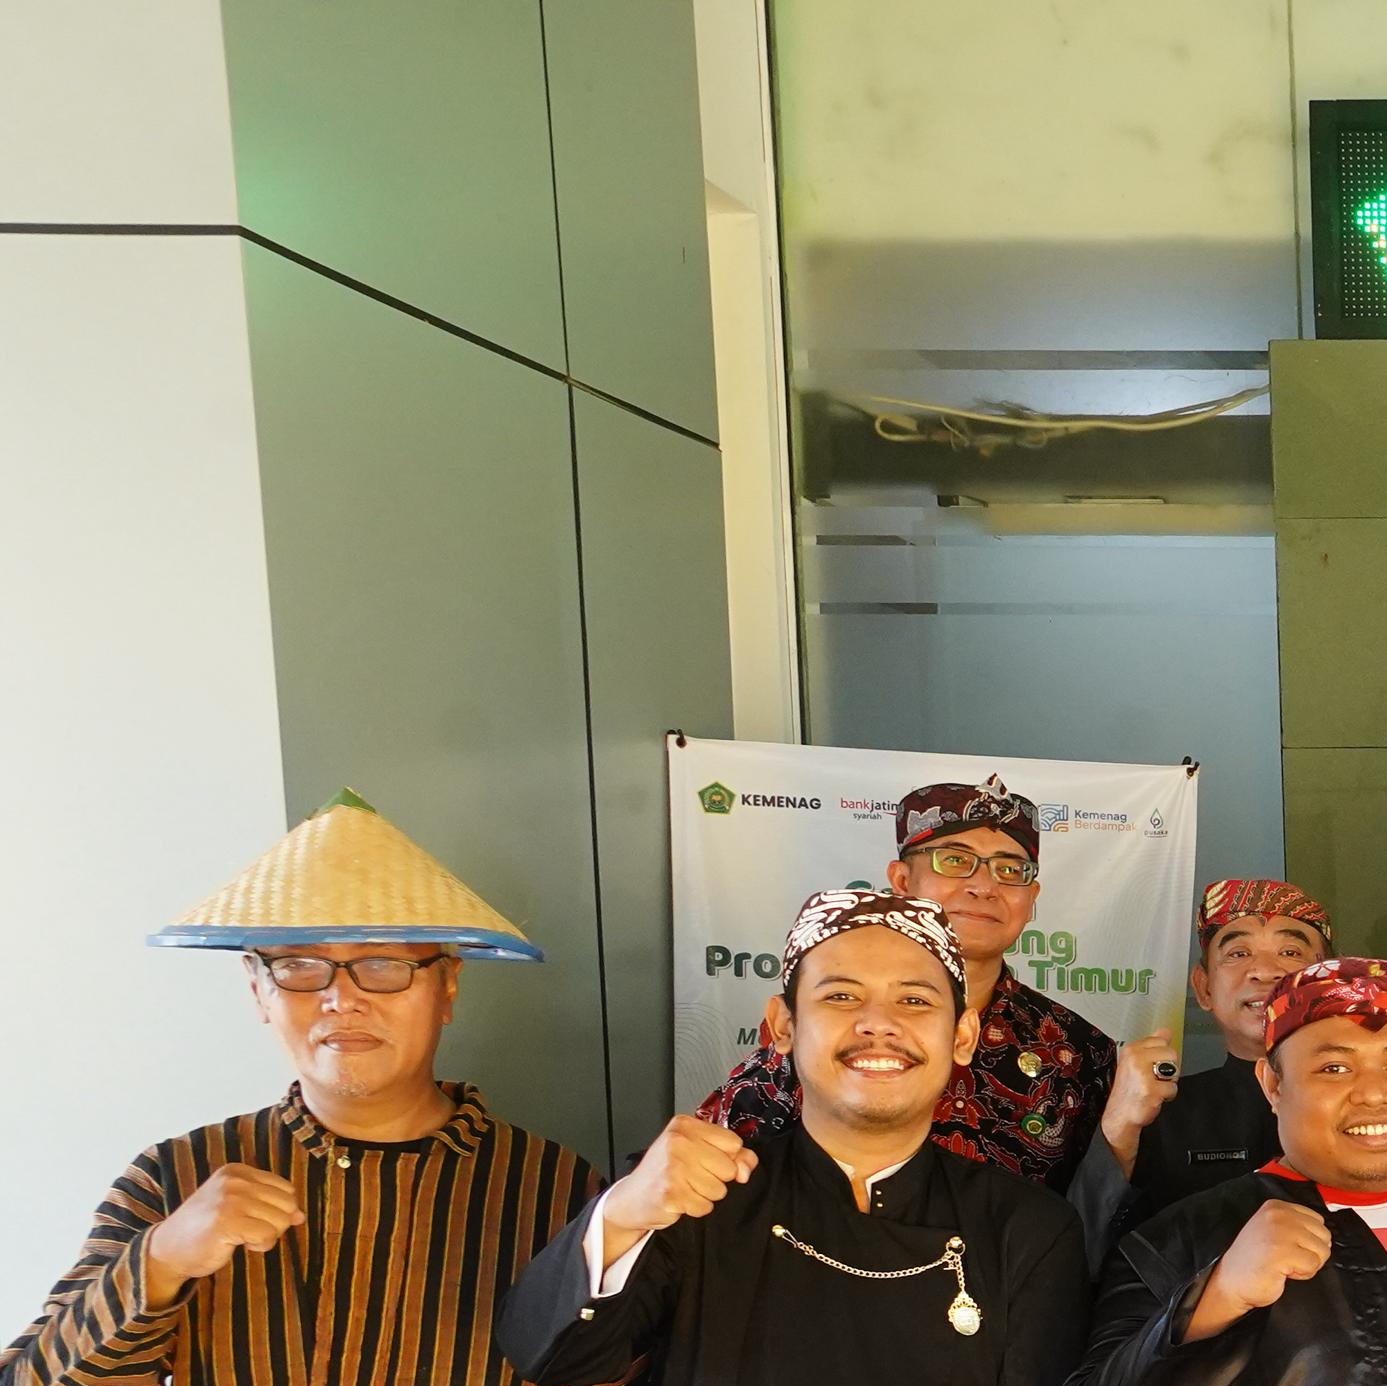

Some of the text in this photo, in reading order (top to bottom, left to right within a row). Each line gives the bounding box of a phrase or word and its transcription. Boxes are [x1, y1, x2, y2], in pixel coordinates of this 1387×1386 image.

[741, 794, 821, 810] KEMENAG
[853, 812, 882, 820] syariah
[1074, 809, 1127, 823] Kemenag
[1074, 820, 1136, 832] Berdampak
[1028, 959, 1155, 995] Timur
